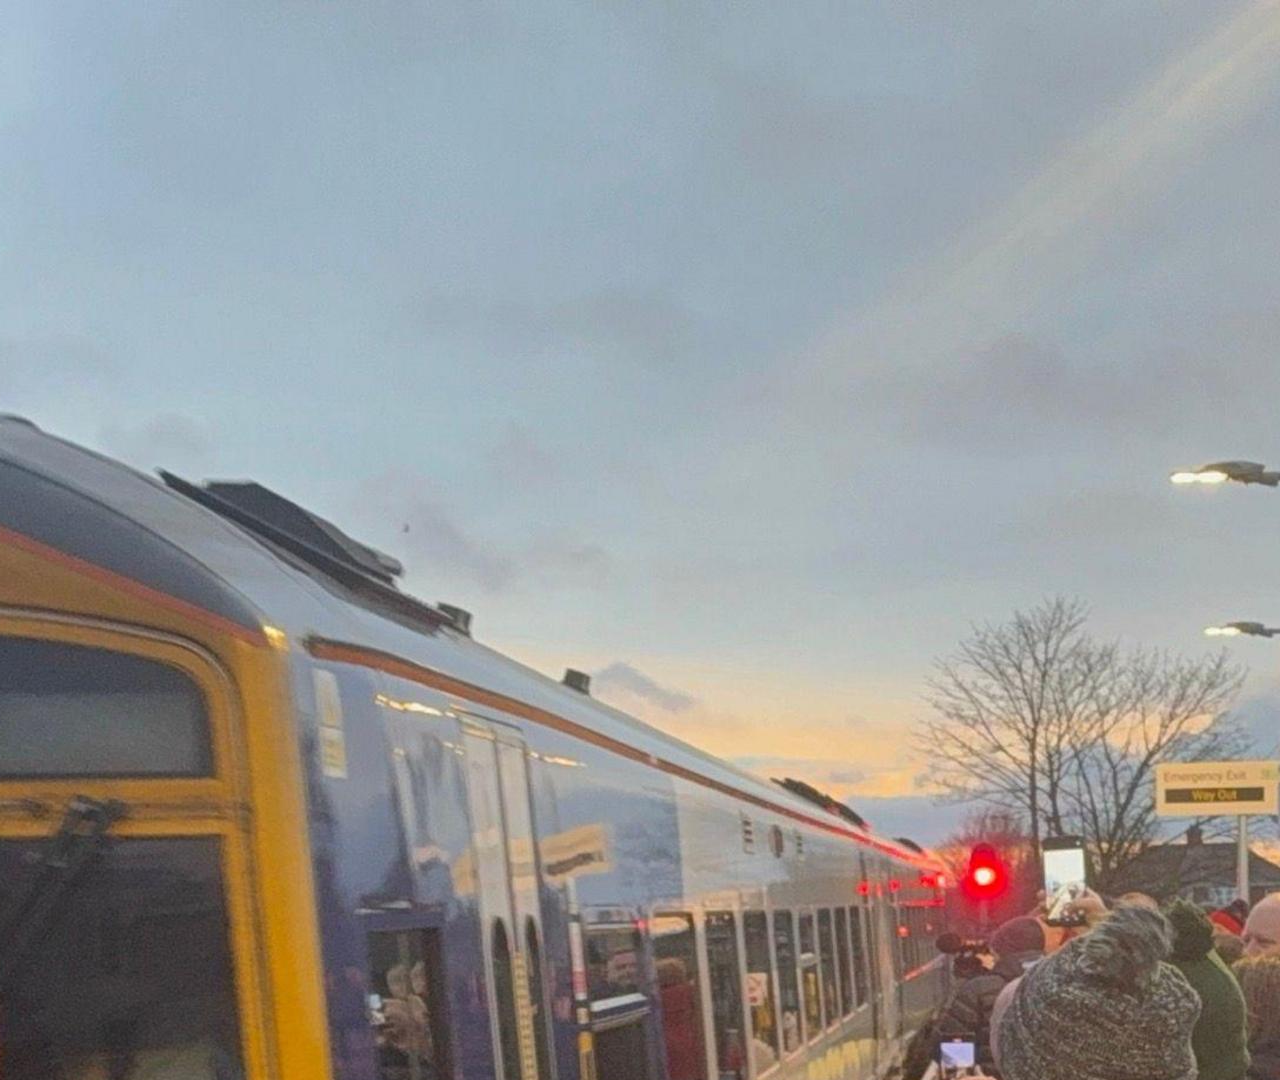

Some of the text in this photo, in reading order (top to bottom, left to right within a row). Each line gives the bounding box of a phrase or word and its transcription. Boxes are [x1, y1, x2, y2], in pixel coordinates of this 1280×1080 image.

[1164, 769, 1247, 783] Emergency Exit
[1191, 789, 1237, 802] Way Out
